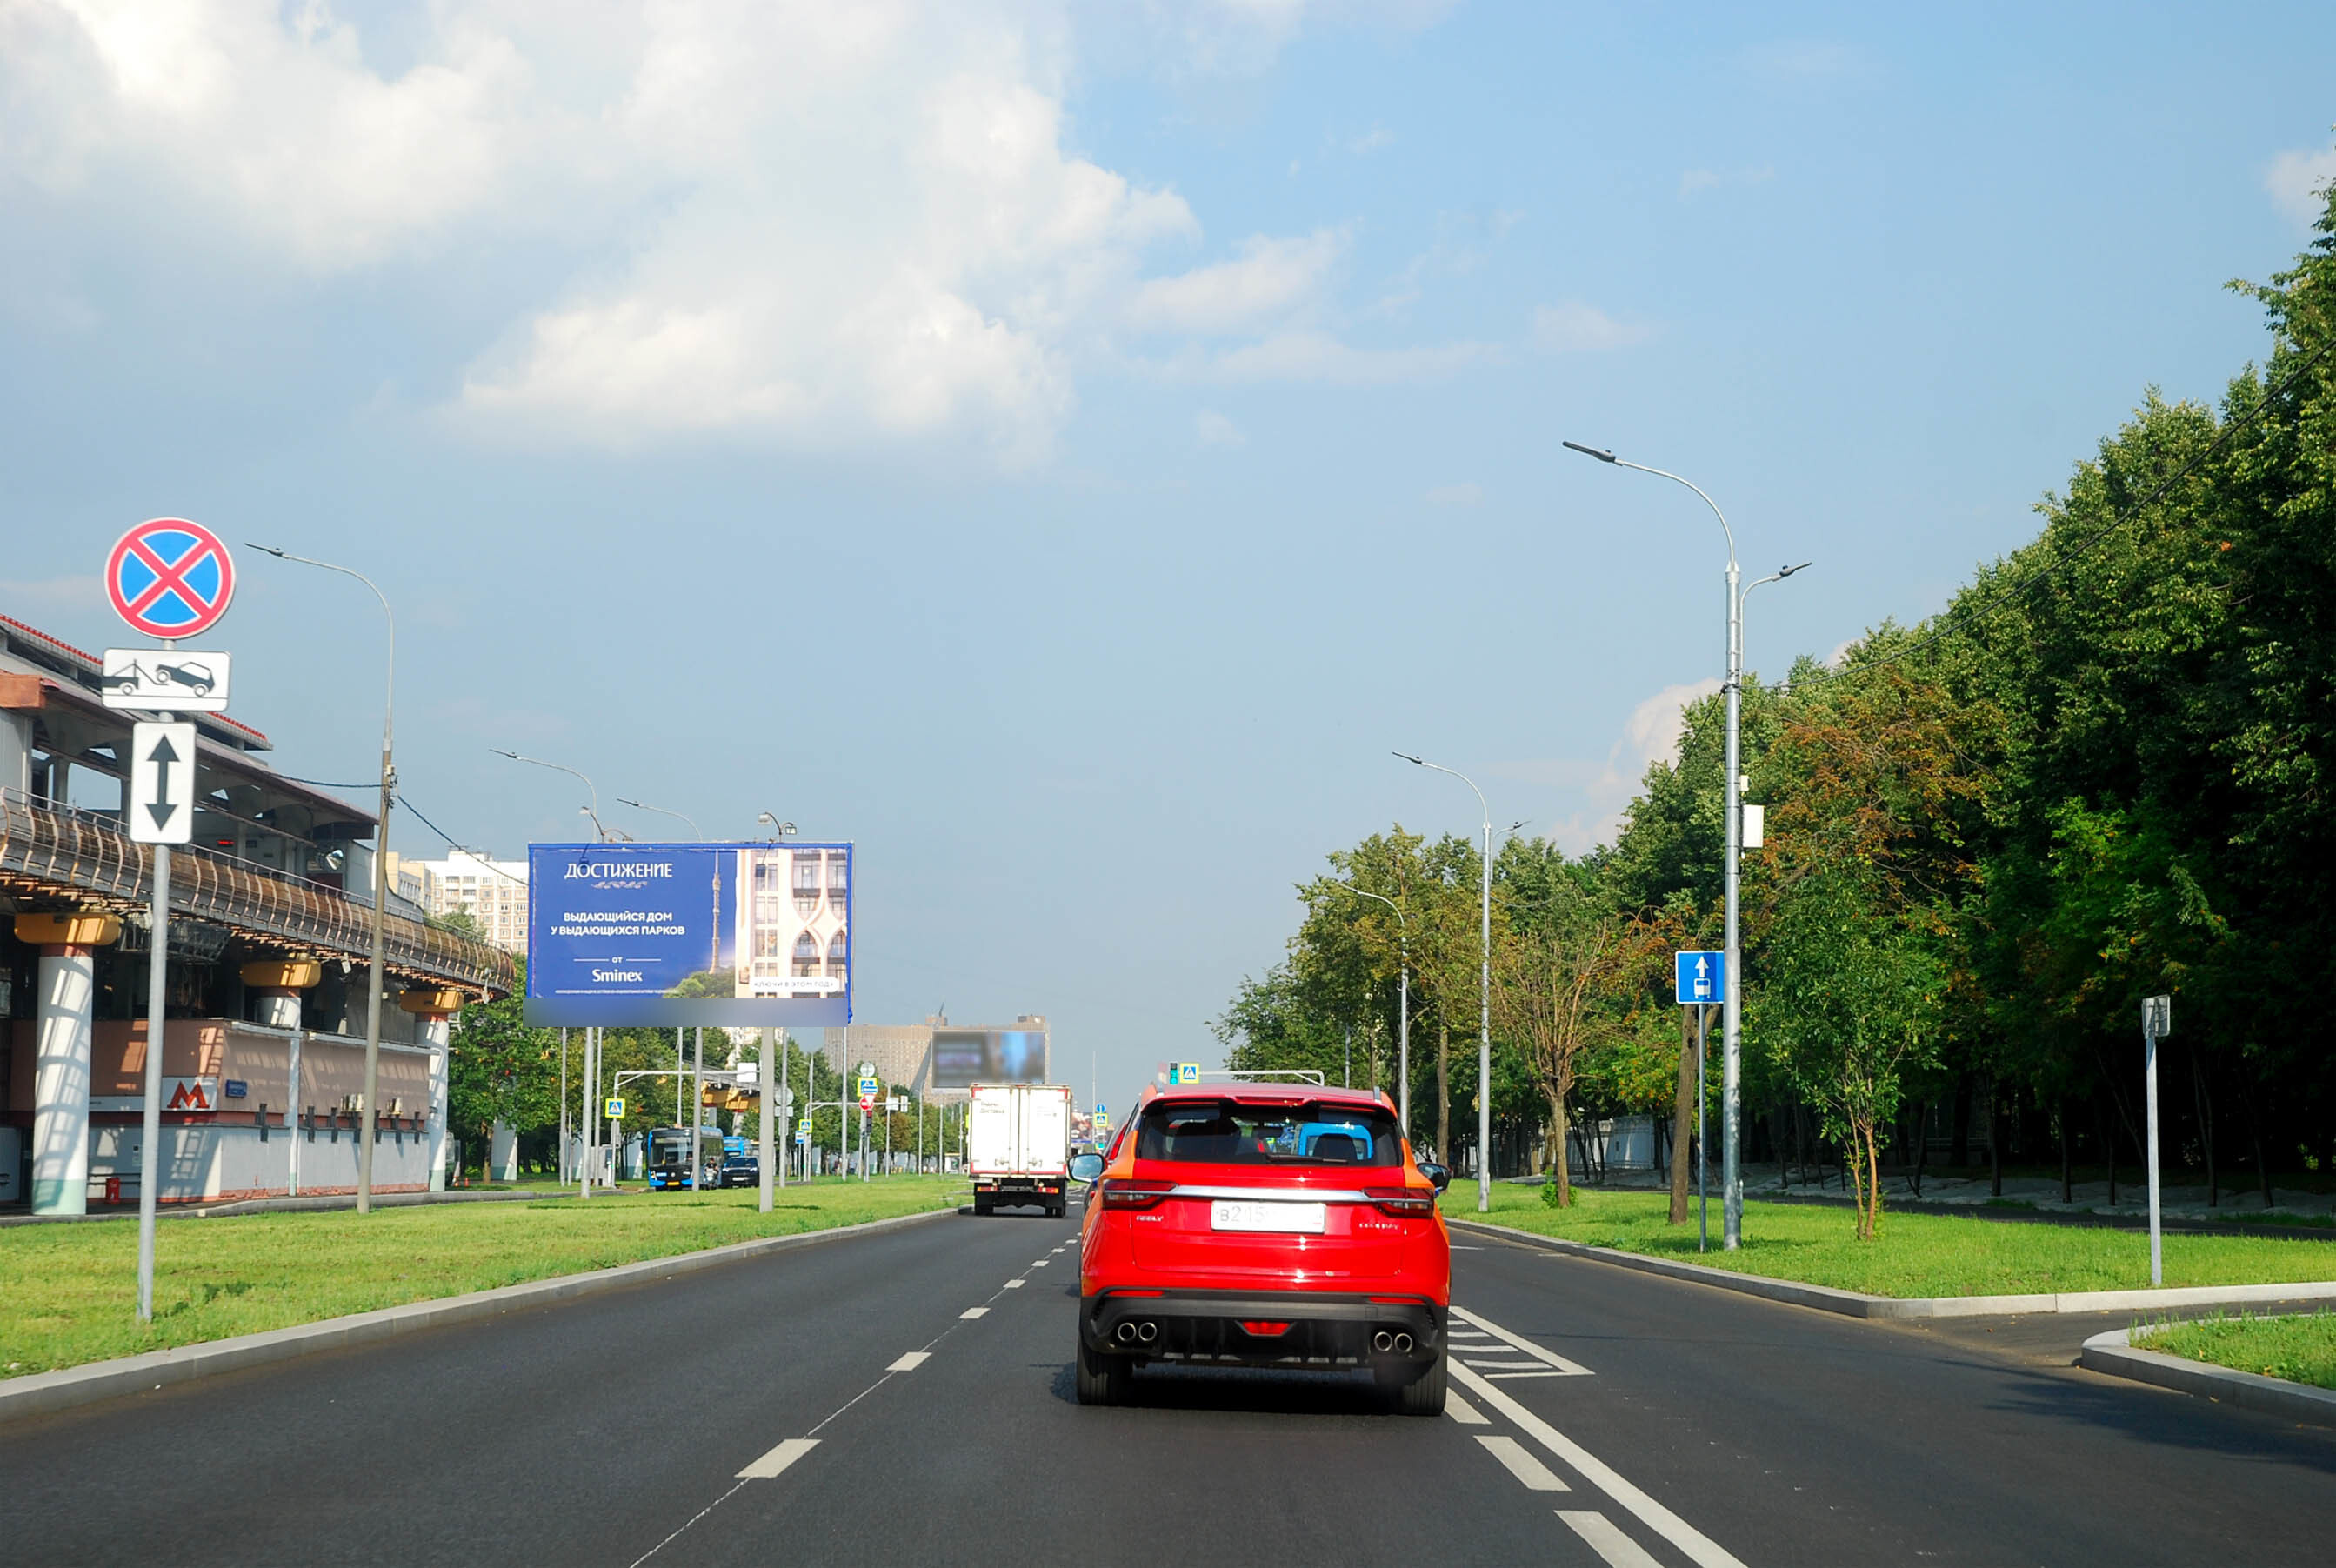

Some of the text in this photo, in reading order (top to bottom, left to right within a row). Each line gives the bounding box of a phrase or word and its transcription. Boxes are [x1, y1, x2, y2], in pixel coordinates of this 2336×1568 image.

[564, 863, 673, 879] ДОСТИЖЕНИЕ
[564, 911, 672, 923] ВЫДАЮЩИЙСЯ ДОМ
[551, 926, 685, 936] У ВЫДАЮЩИХСЯ ПАРКОВ
[592, 969, 644, 982] Sminex
